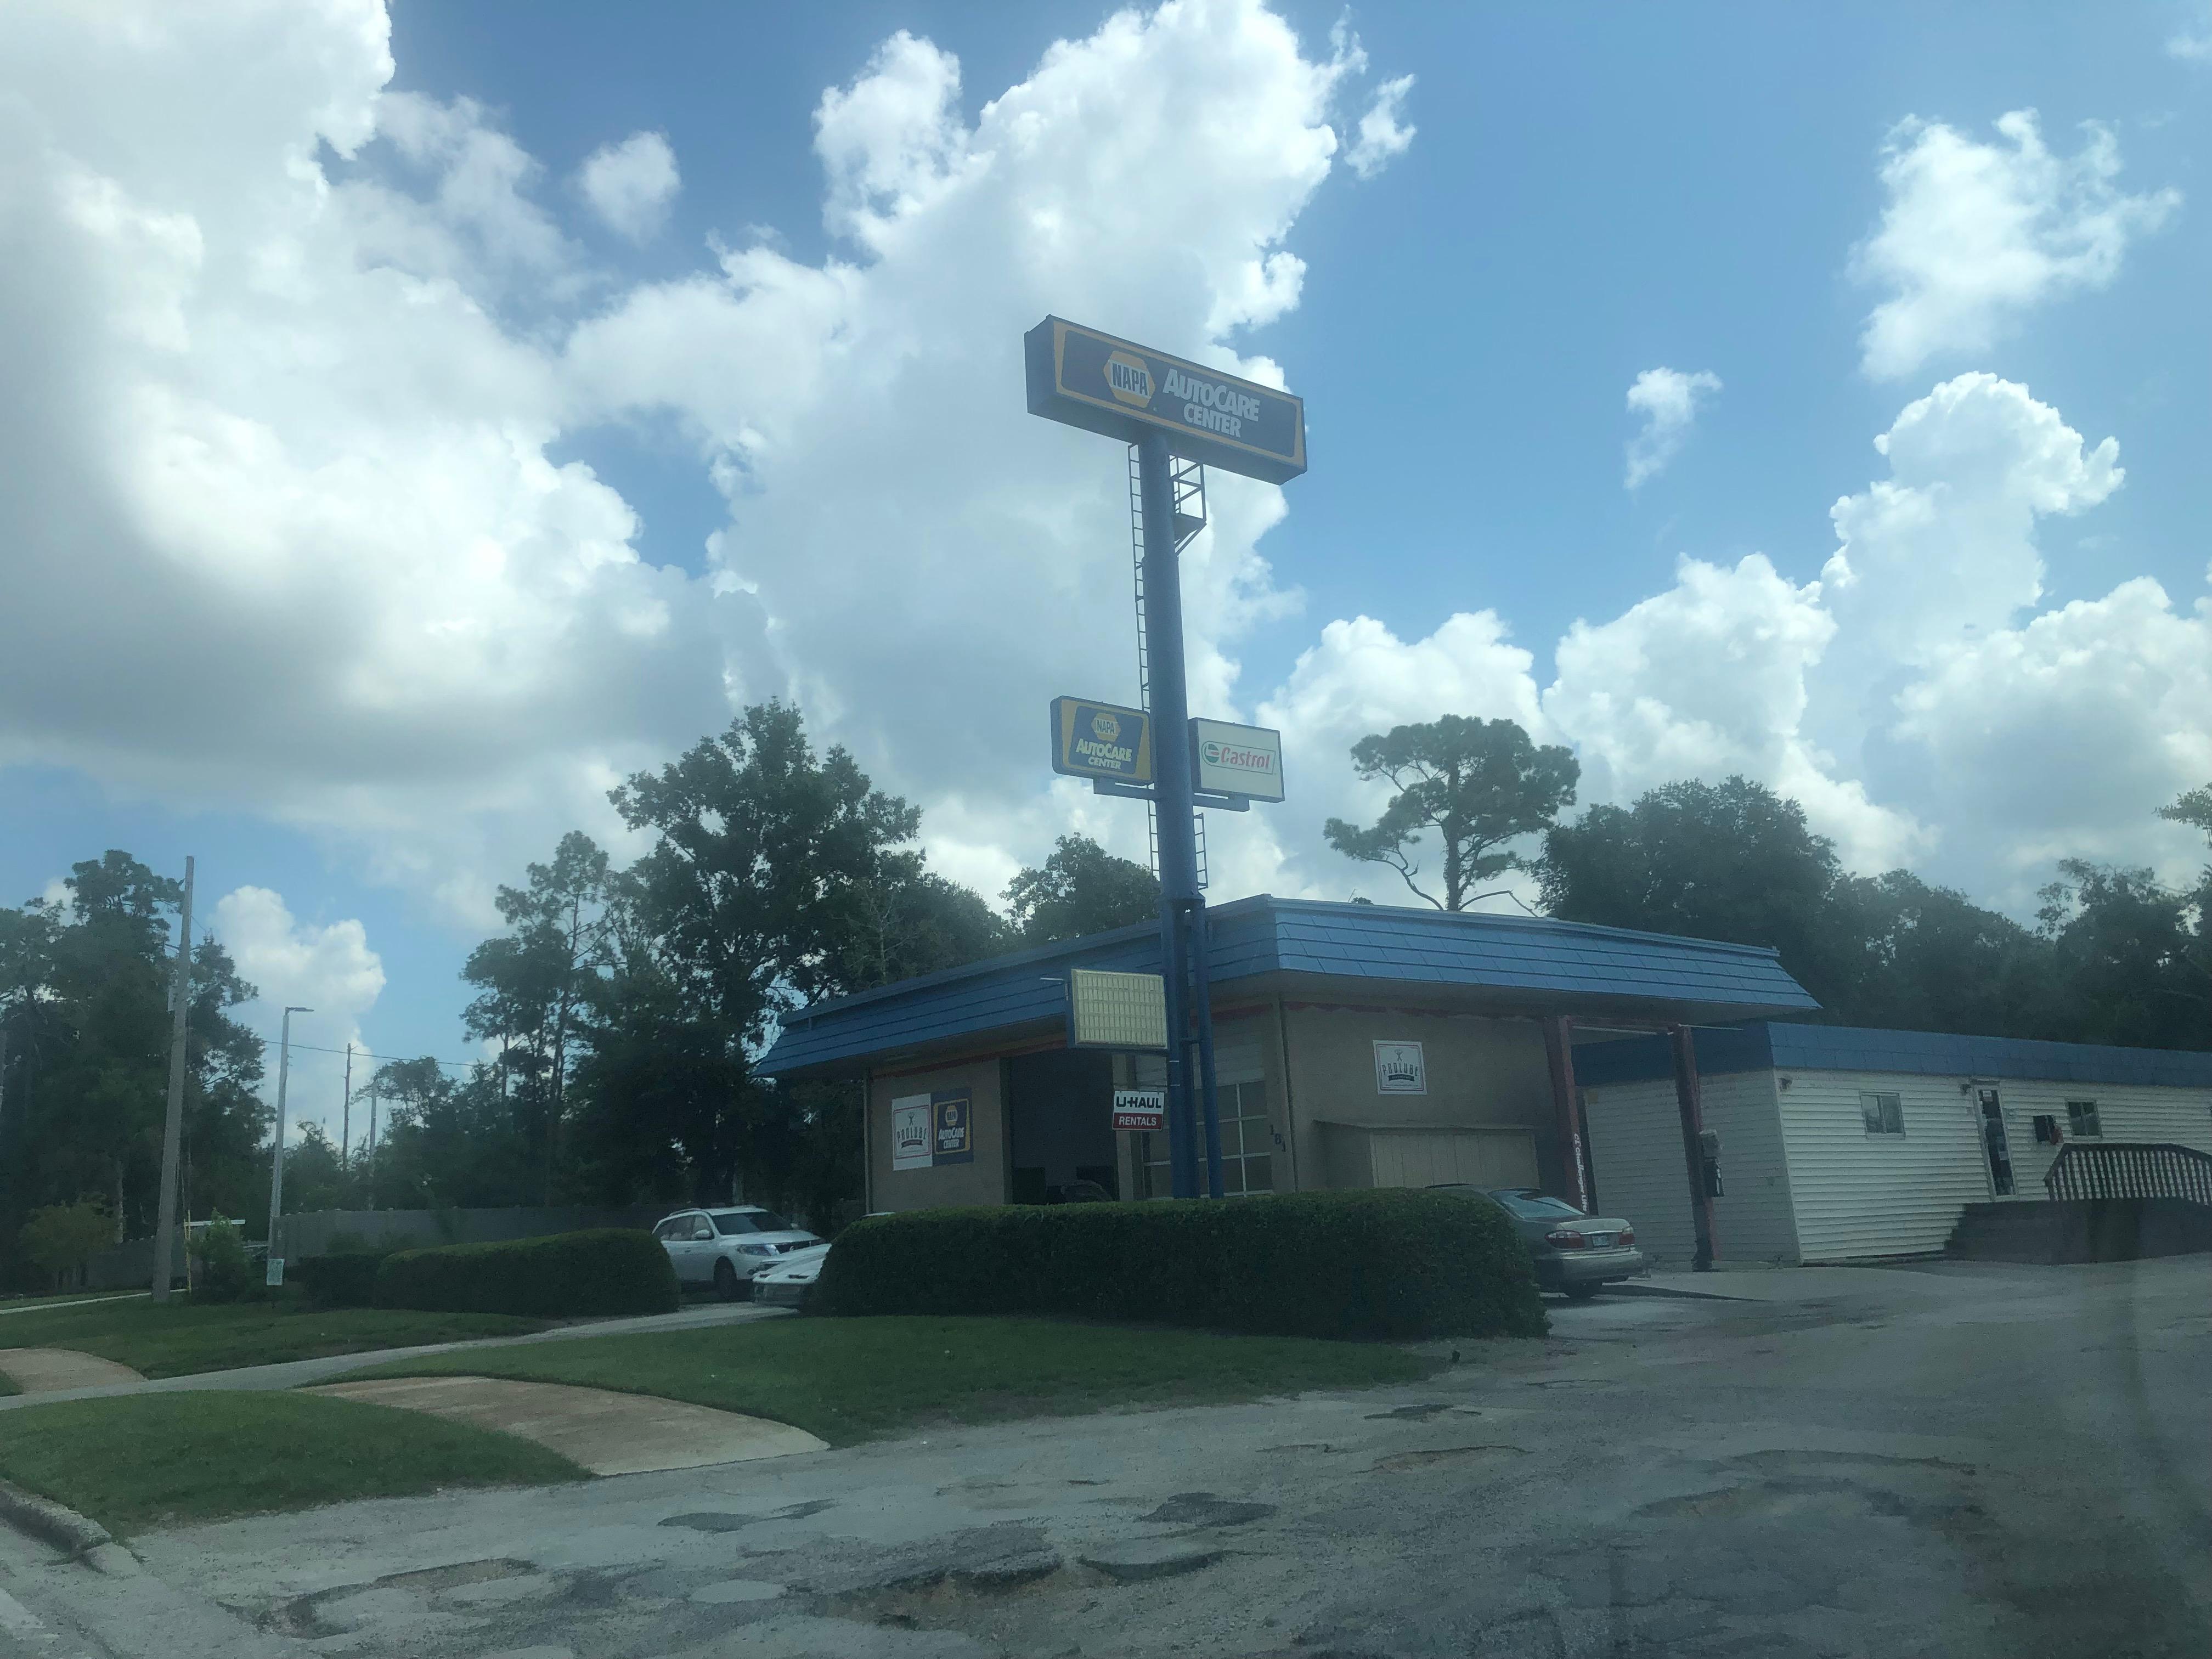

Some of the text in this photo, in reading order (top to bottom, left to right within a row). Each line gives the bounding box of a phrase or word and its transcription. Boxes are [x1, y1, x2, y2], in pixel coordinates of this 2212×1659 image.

[1111, 363, 1148, 396] NAPA
[1162, 368, 1261, 422] AUTOCARE
[1183, 402, 1242, 438] CENTER
[1096, 719, 1116, 734] NAPA
[1075, 738, 1133, 763] AUTOCARE
[1220, 747, 1270, 769] Castrol
[1088, 755, 1122, 770] CENTER
[1116, 1096, 1162, 1109] U-HAUL
[1119, 1116, 1156, 1126] RENTALS
